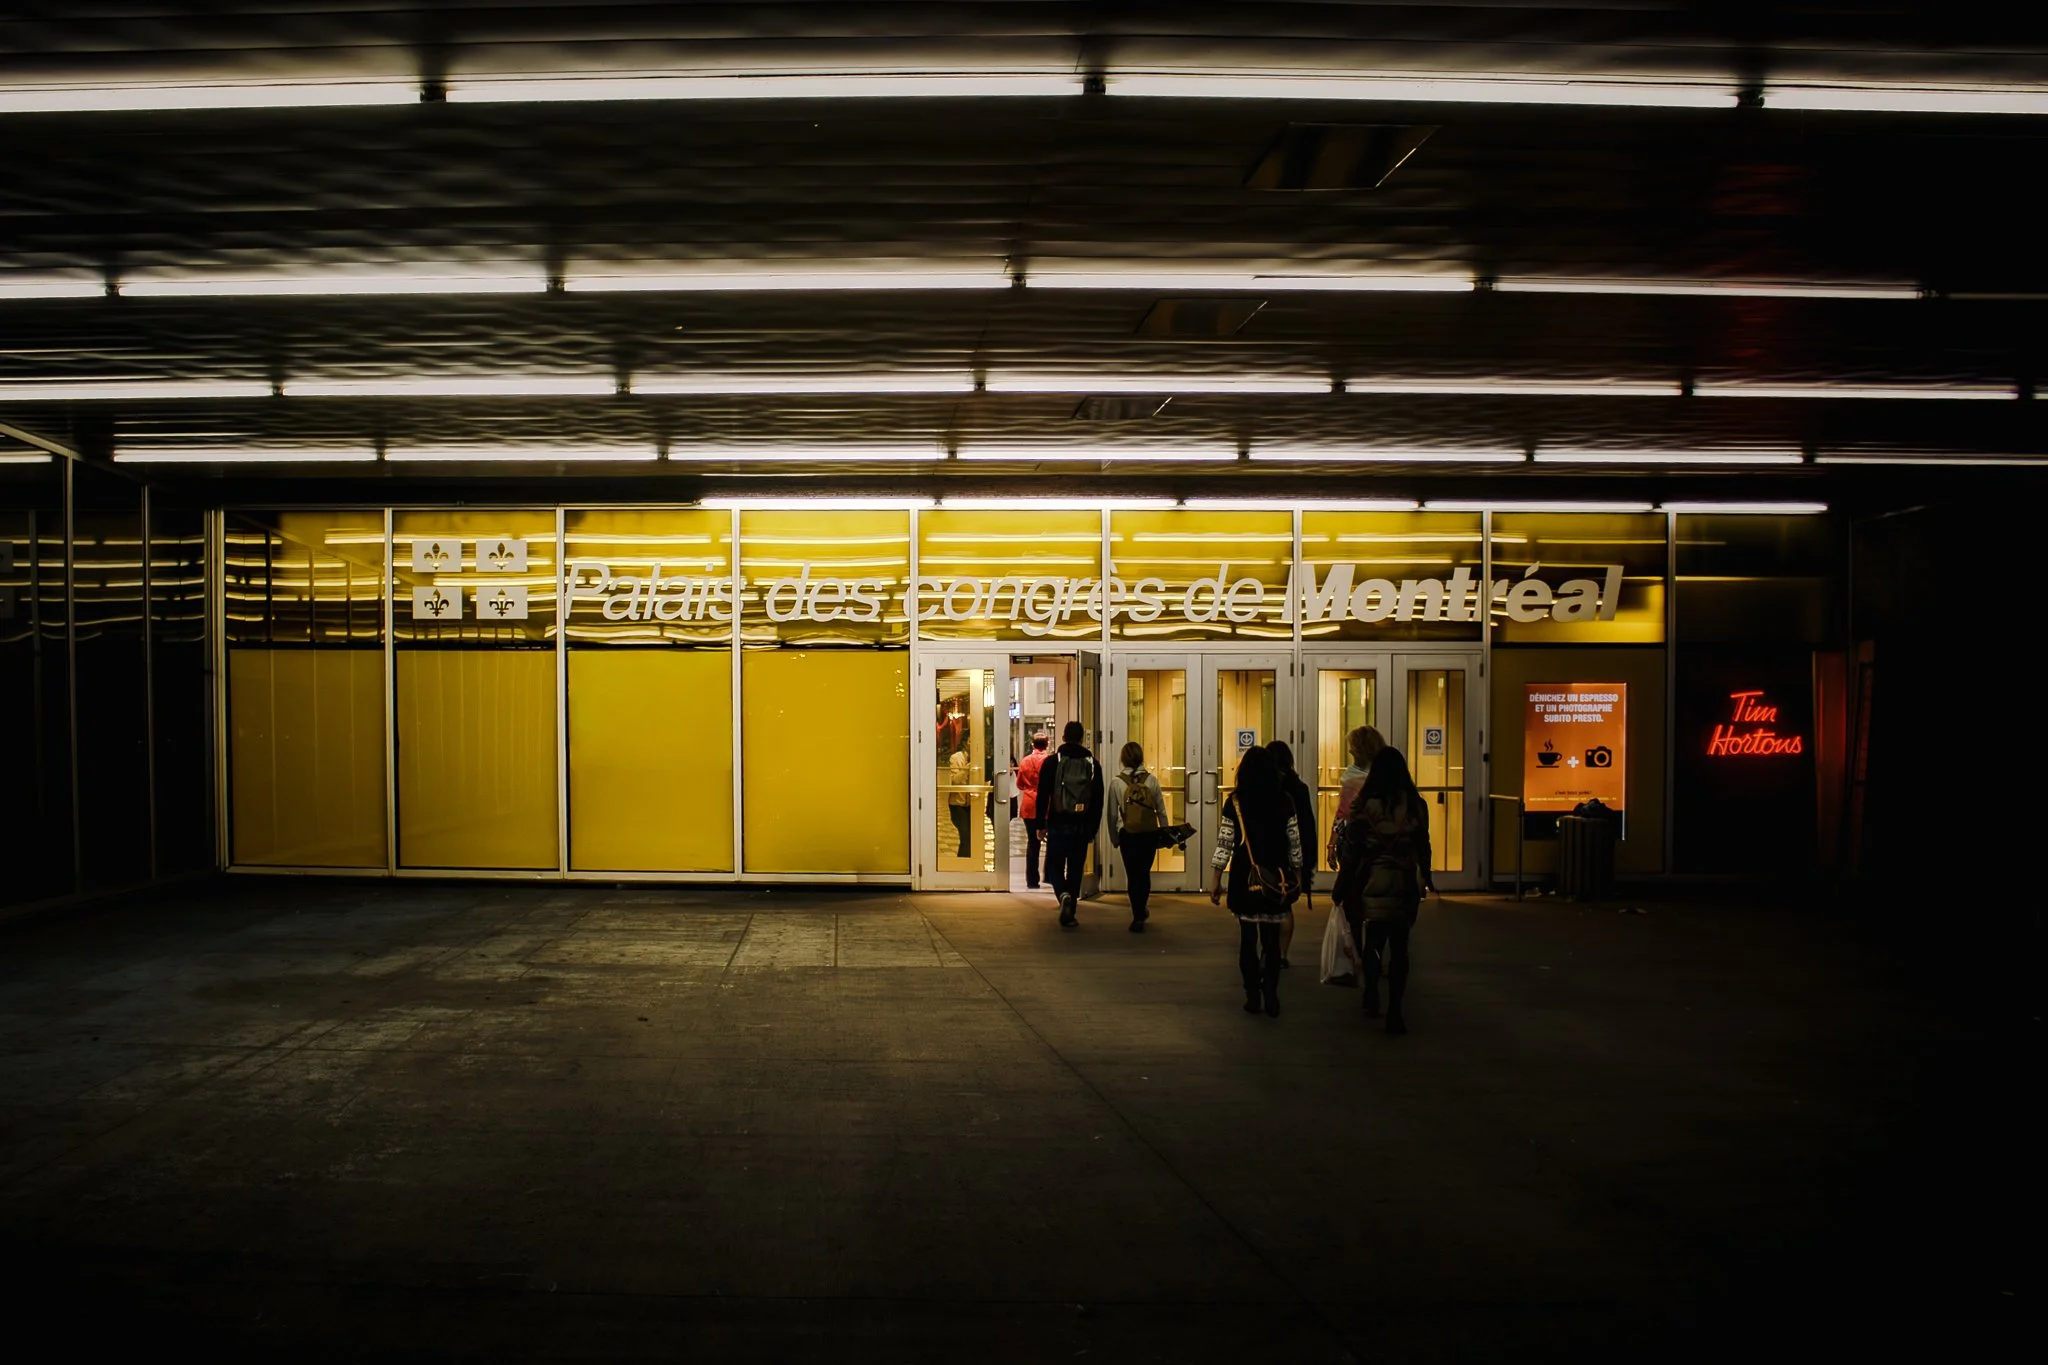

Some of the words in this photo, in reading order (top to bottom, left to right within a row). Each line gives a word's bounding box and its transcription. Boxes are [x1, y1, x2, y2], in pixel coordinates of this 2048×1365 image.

[564, 562, 747, 622] Palais
[766, 562, 884, 622] des
[903, 560, 1165, 636] congrès
[1184, 562, 1264, 622] de
[1281, 560, 1624, 623] Montréal
[1529, 692, 1566, 702] DÉNICHEZ
[1567, 693, 1578, 702] UN
[1580, 693, 1619, 702] ESPRESSO
[1729, 690, 1777, 723] Tim
[1535, 704, 1544, 712] ET
[1546, 704, 1557, 712] UN
[1558, 704, 1613, 712] PHOTOGRAPHE
[1544, 714, 1571, 722] SUBITO
[1572, 714, 1604, 722] PRESTO.
[1707, 724, 1802, 756] Hortons
